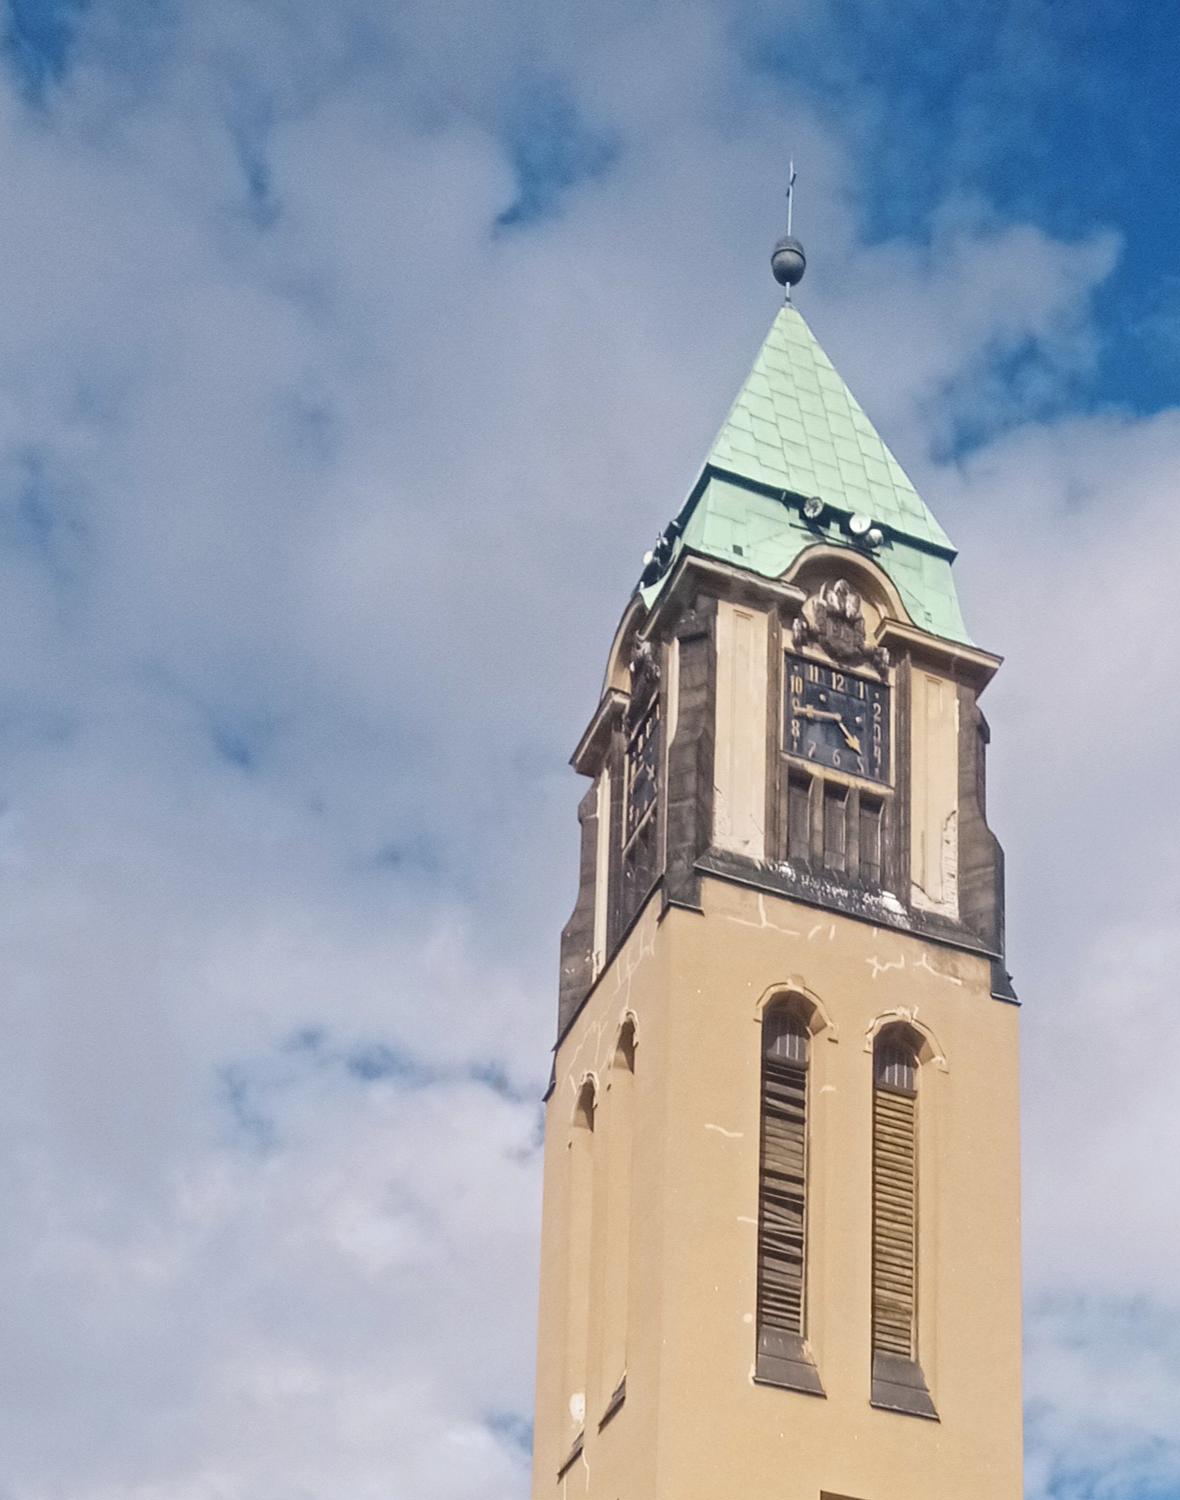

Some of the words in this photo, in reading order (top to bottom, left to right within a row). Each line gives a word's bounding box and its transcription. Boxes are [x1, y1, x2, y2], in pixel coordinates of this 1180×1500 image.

[809, 664, 819, 683] 11
[832, 672, 844, 692] 12
[790, 674, 803, 694] 10
[858, 681, 864, 699] 1
[873, 702, 881, 721] 2
[791, 719, 800, 738] 8
[807, 740, 816, 759] 7
[832, 748, 841, 766] 6
